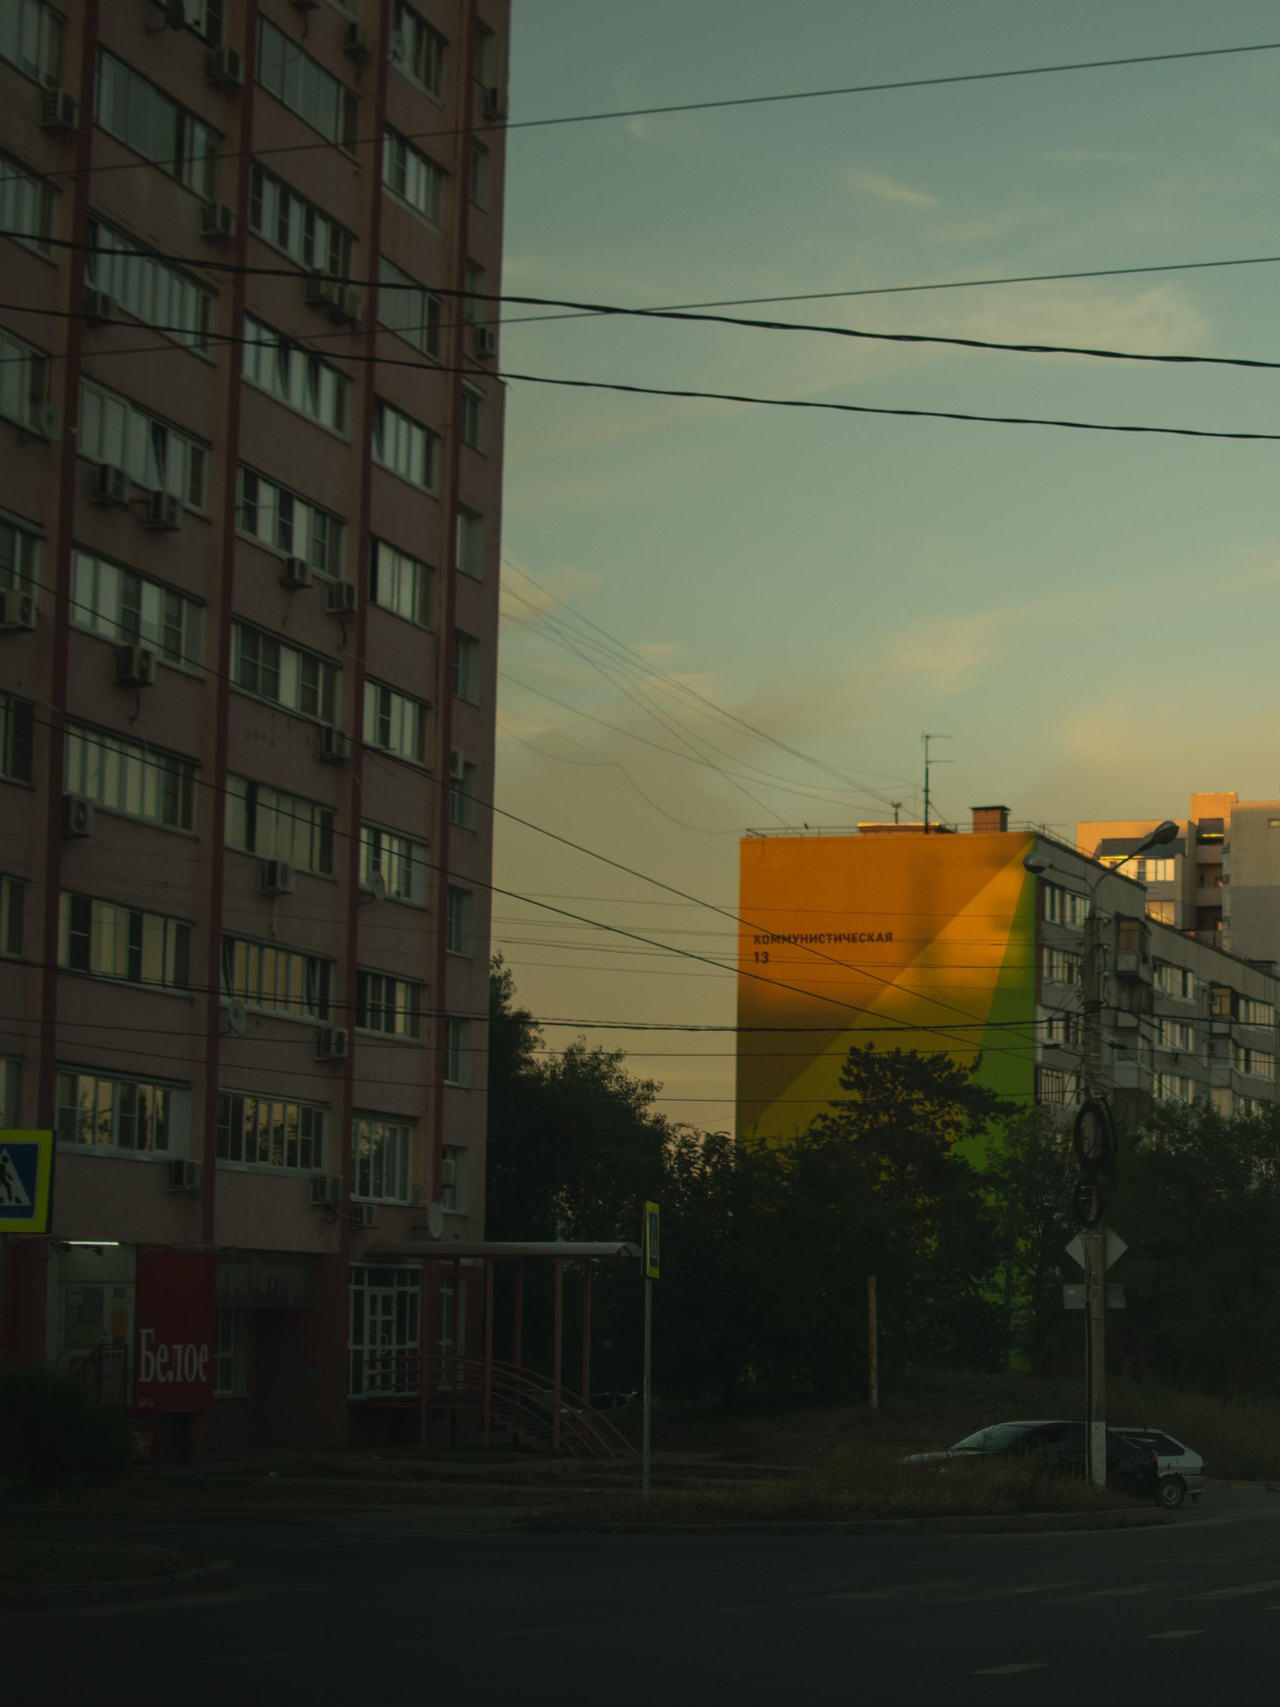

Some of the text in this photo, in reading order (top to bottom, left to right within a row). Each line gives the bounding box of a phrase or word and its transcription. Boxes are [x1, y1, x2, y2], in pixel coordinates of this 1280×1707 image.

[753, 932, 893, 945] КОММУНИСТИЧЕСКАЯ
[753, 951, 770, 964] 13
[138, 1328, 210, 1384] Белое
